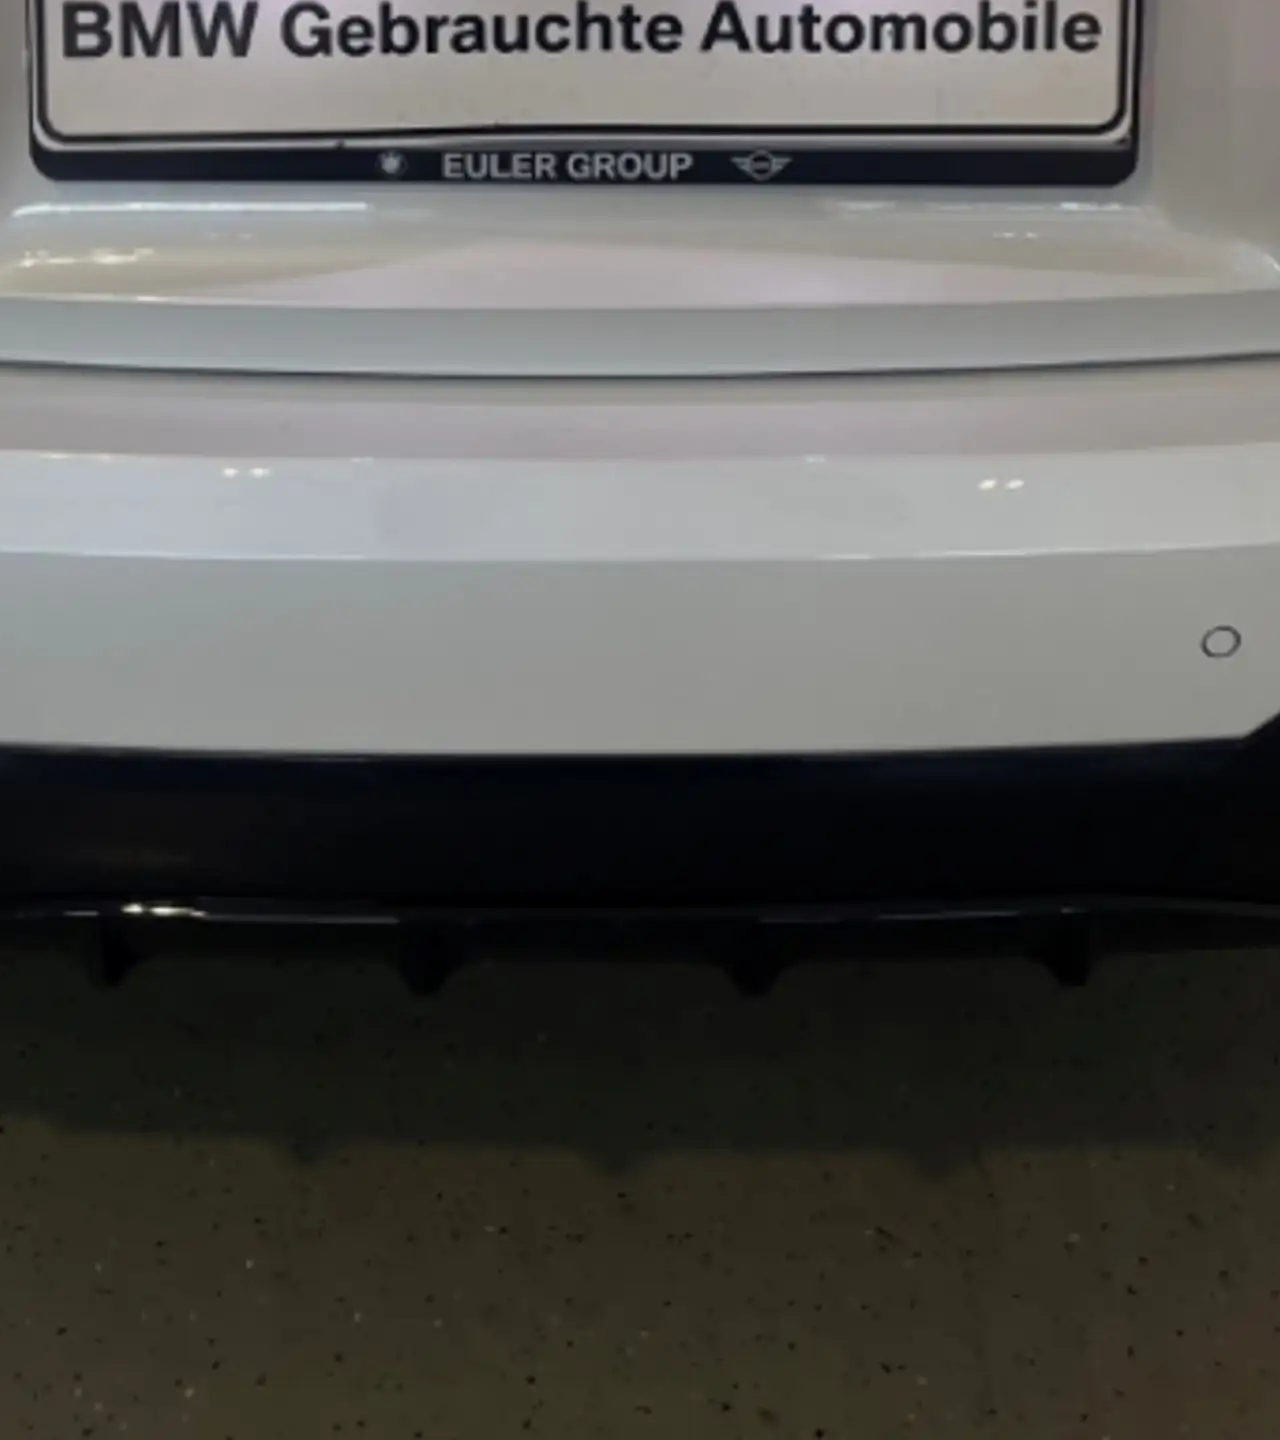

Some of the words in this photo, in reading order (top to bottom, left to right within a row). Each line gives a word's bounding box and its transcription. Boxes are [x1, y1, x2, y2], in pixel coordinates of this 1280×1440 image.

[61, 1, 259, 58] BMW
[442, 151, 556, 180] EULER
[567, 151, 693, 180] GROUP
